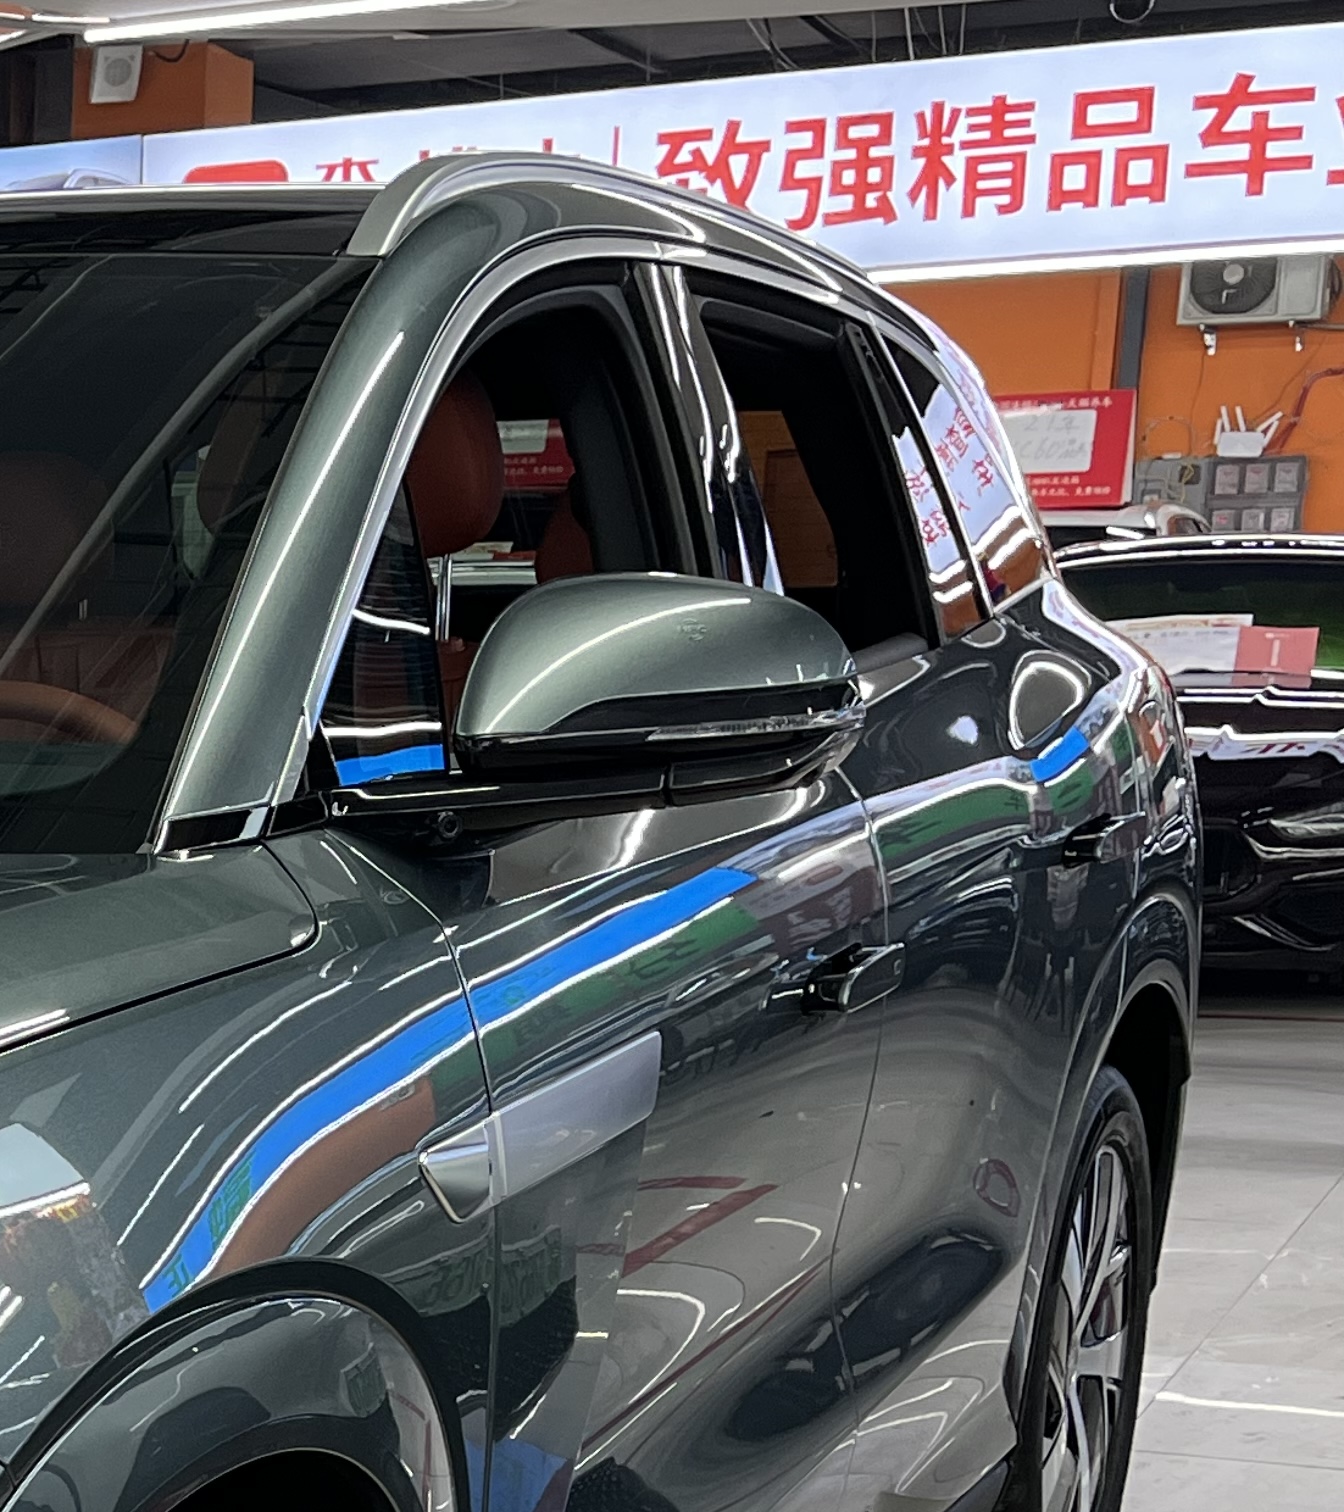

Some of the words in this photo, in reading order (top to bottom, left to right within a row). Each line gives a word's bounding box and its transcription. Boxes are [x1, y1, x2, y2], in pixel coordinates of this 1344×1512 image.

[654, 72, 1344, 234] 致强精品车
